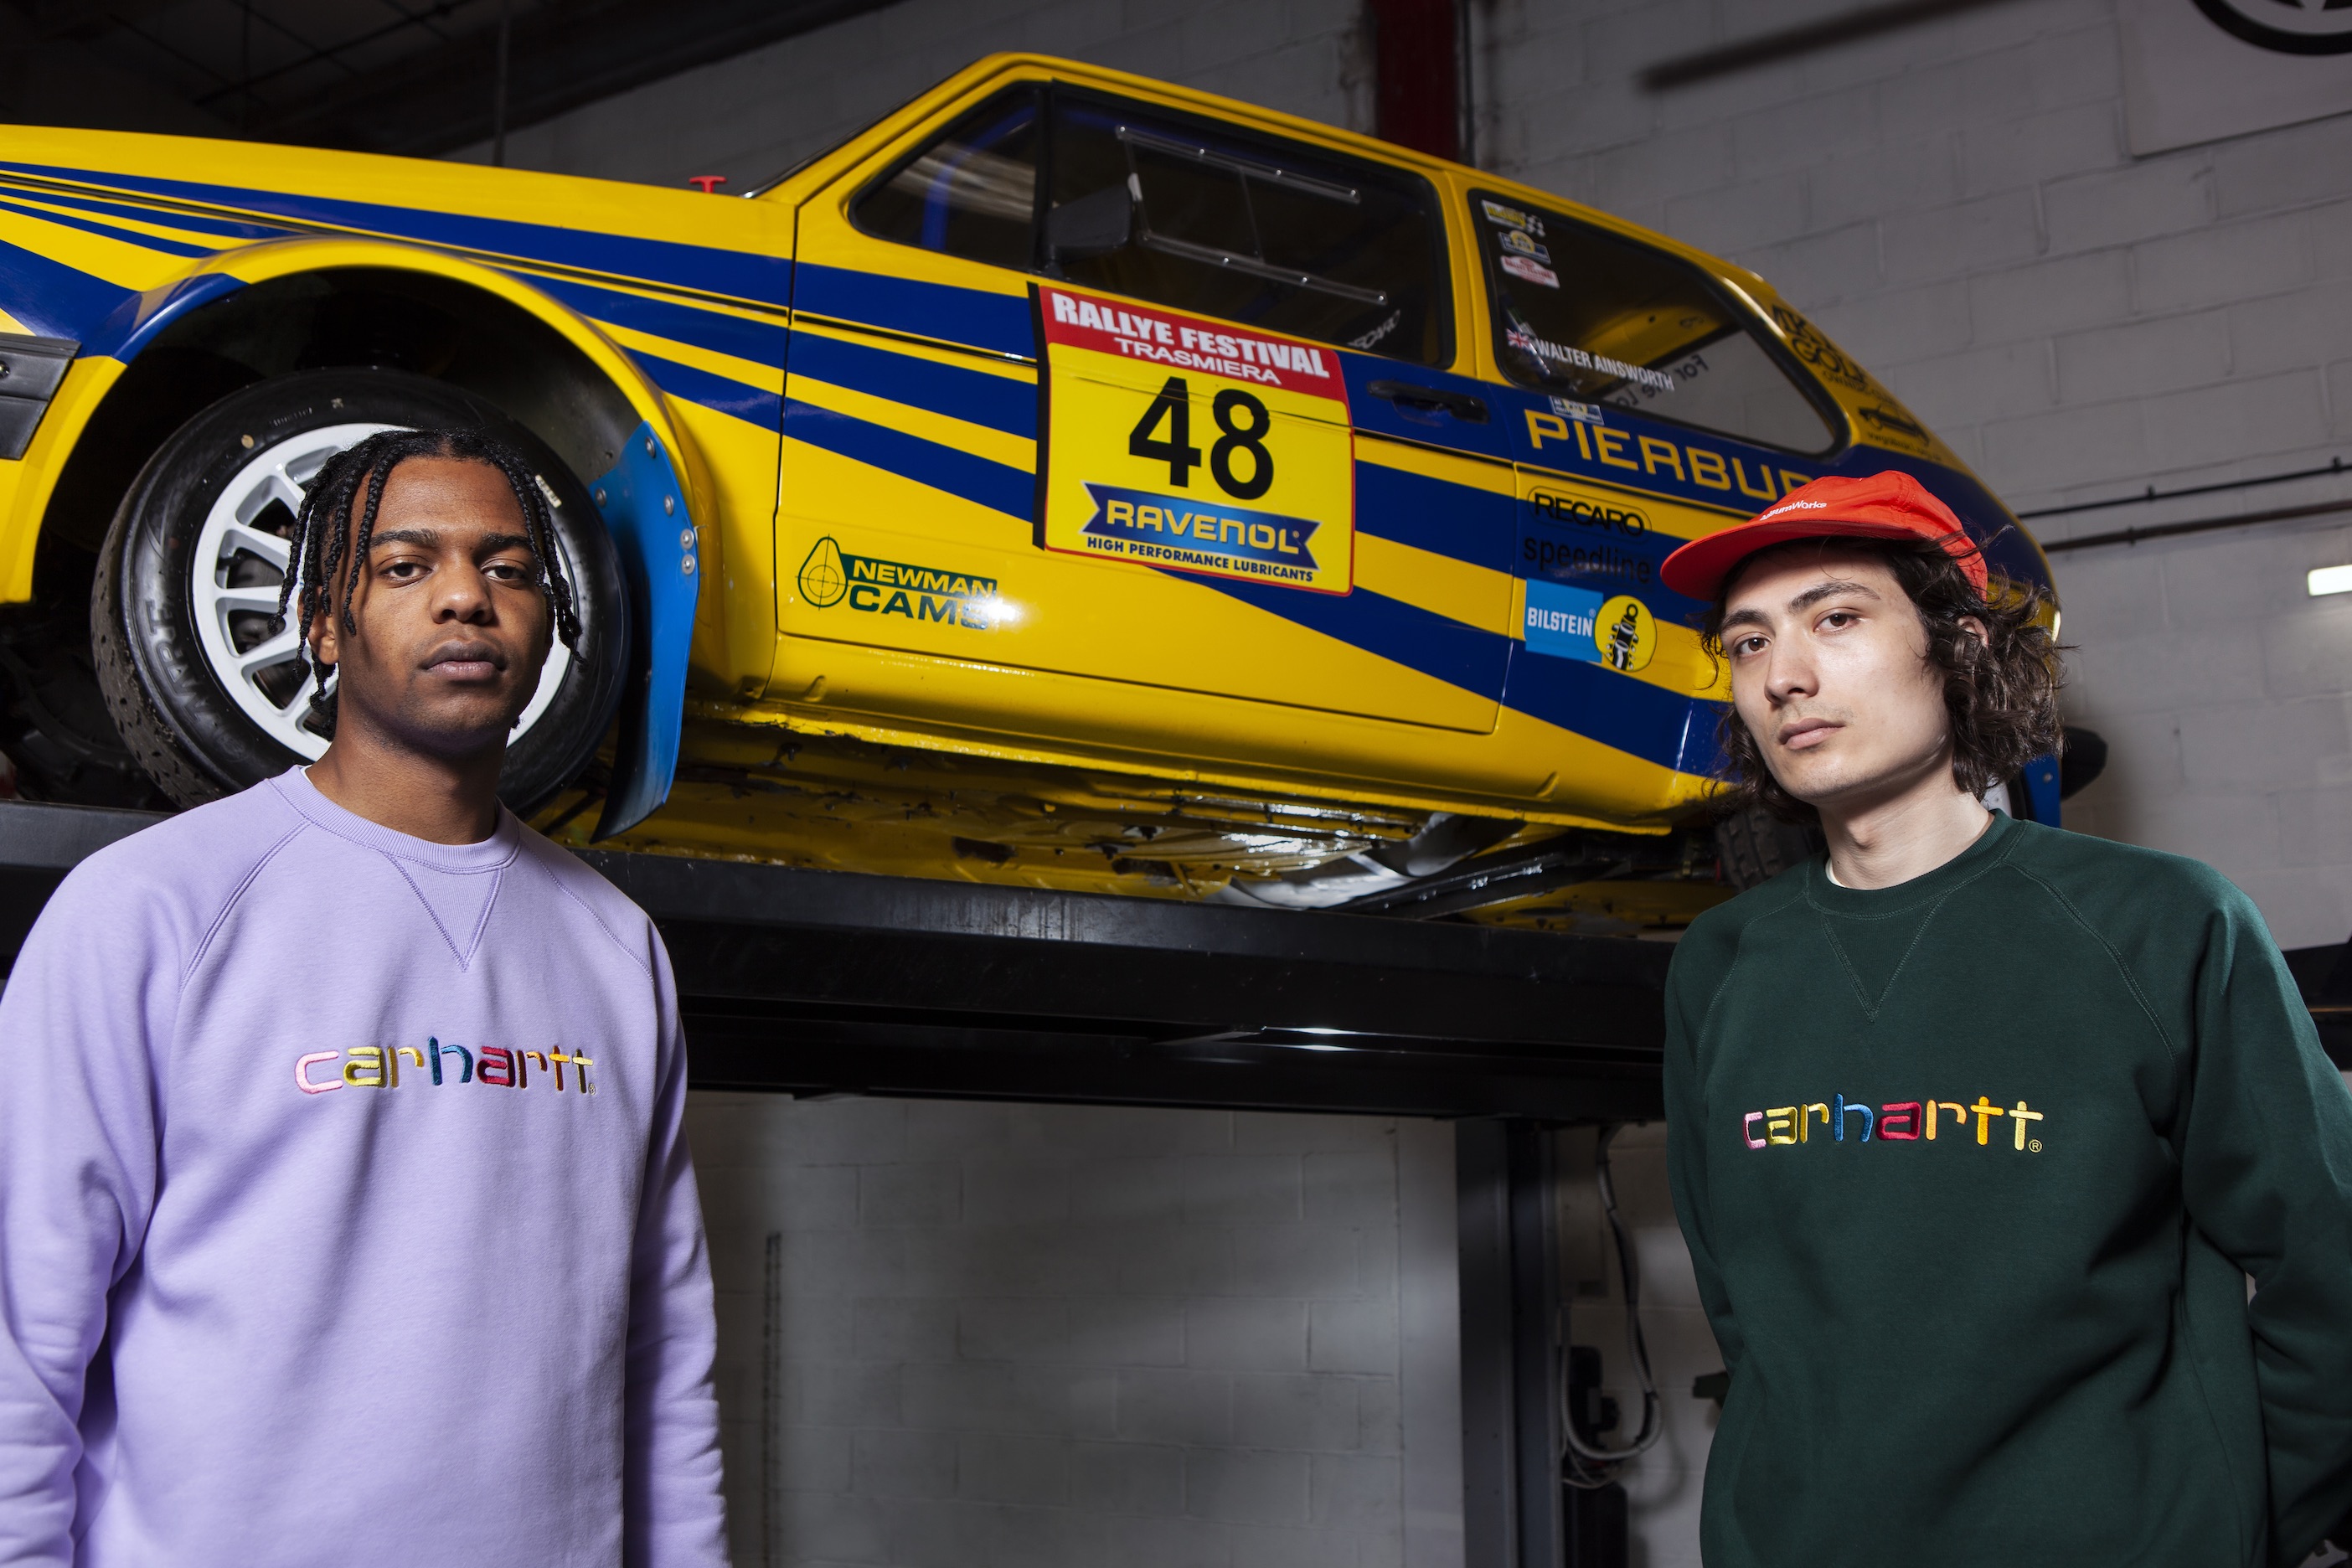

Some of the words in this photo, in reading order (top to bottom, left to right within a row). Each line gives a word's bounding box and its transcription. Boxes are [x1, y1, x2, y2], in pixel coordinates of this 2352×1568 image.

[1051, 291, 1174, 345] RALLYE
[1179, 326, 1330, 379] FESTIVAL
[1114, 337, 1282, 385] TRASMIERA
[1536, 338, 1592, 369] WALTER
[1594, 354, 1675, 392] AINSWORTH
[1128, 376, 1274, 501] 48
[1106, 499, 1300, 554] RAVENOL
[1534, 492, 1645, 538] RECARO
[852, 559, 994, 598] NEWMAN
[1087, 537, 1124, 553] HIGH
[1129, 543, 1230, 570] PERFORMANCE
[1233, 560, 1313, 583] LUBRICANTS
[1523, 536, 1652, 585] speedline
[848, 584, 989, 631] CAMS
[1527, 606, 1594, 638] BILSTEIN
[294, 1035, 594, 1095] carhartt
[1742, 1092, 2044, 1151] carhartt
